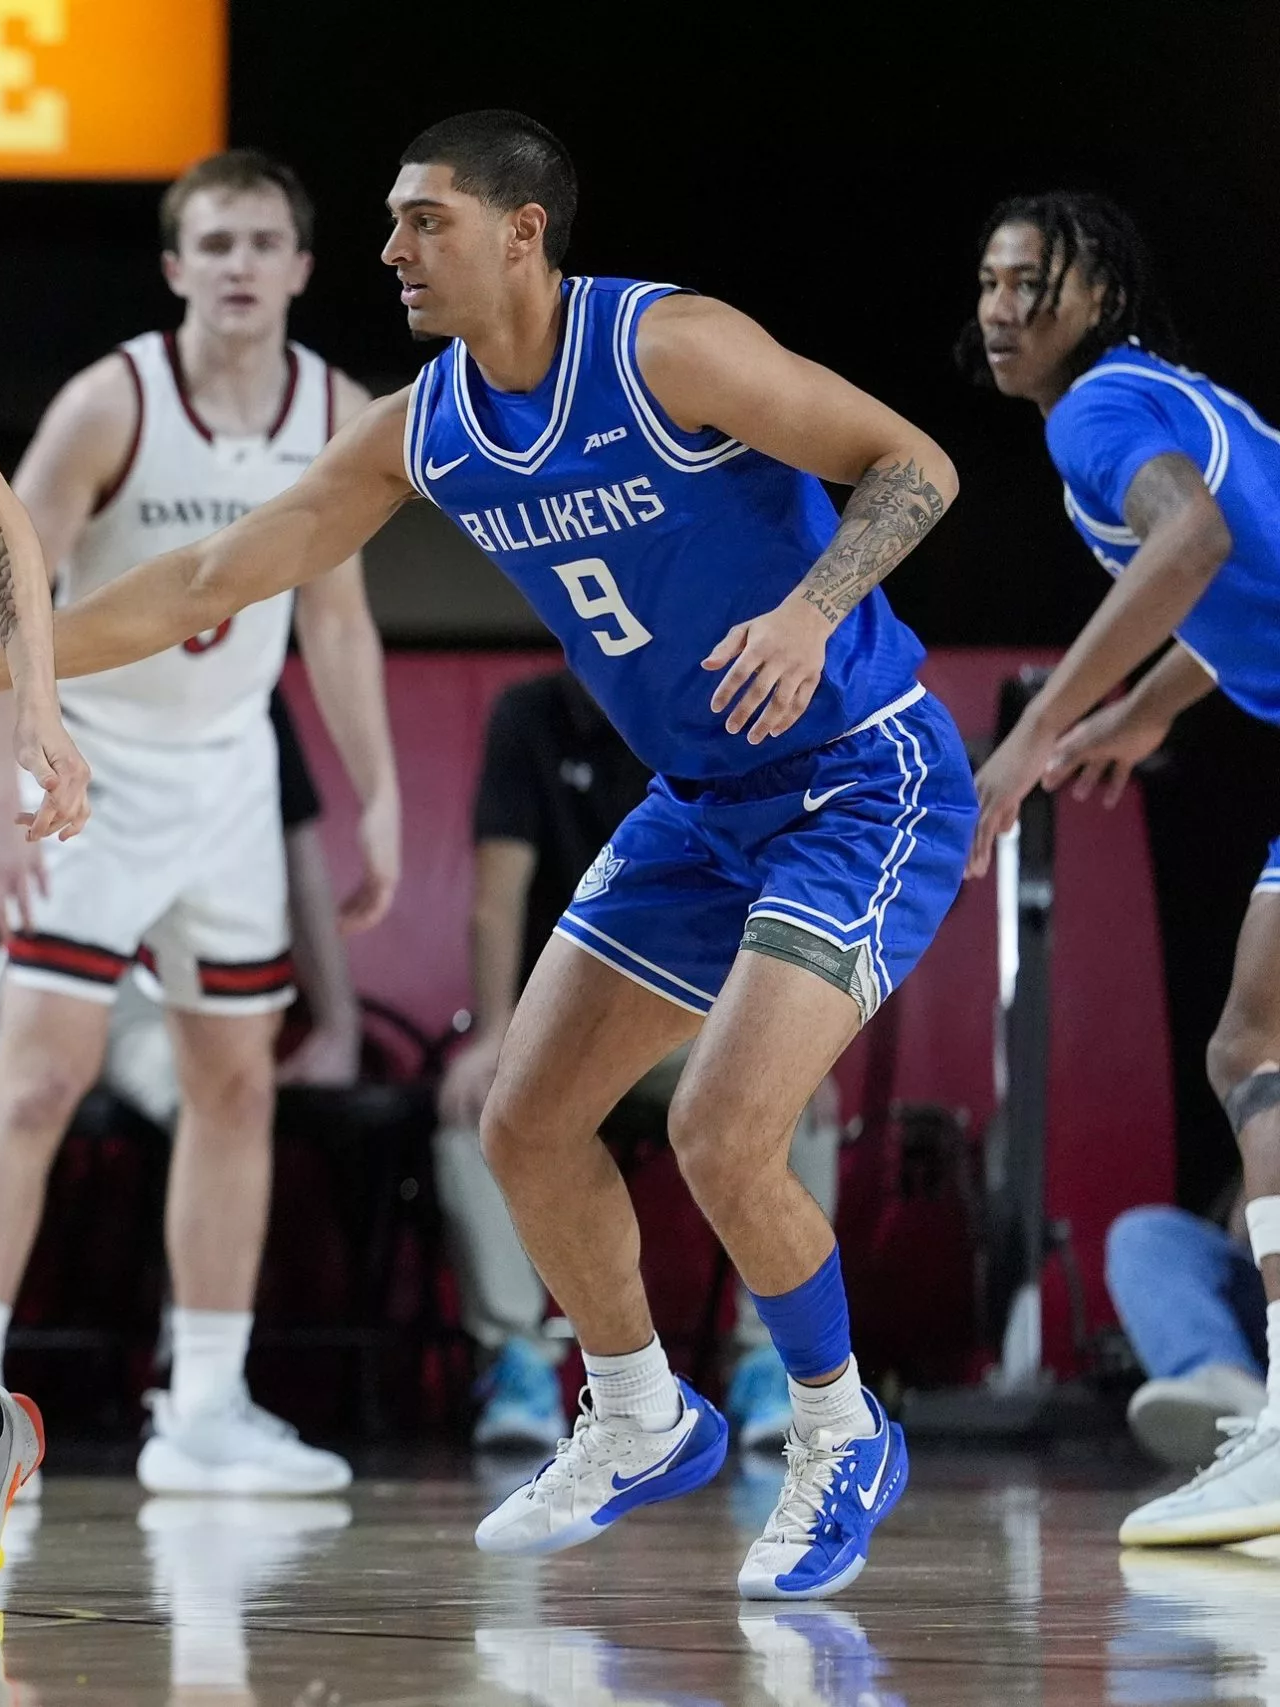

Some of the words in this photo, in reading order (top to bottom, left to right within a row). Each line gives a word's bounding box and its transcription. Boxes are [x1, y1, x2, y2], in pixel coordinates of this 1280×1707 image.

[582, 426, 628, 455] A10
[139, 497, 254, 526] DAVID
[459, 475, 666, 552] BILLIKENS
[551, 557, 654, 657] 9
